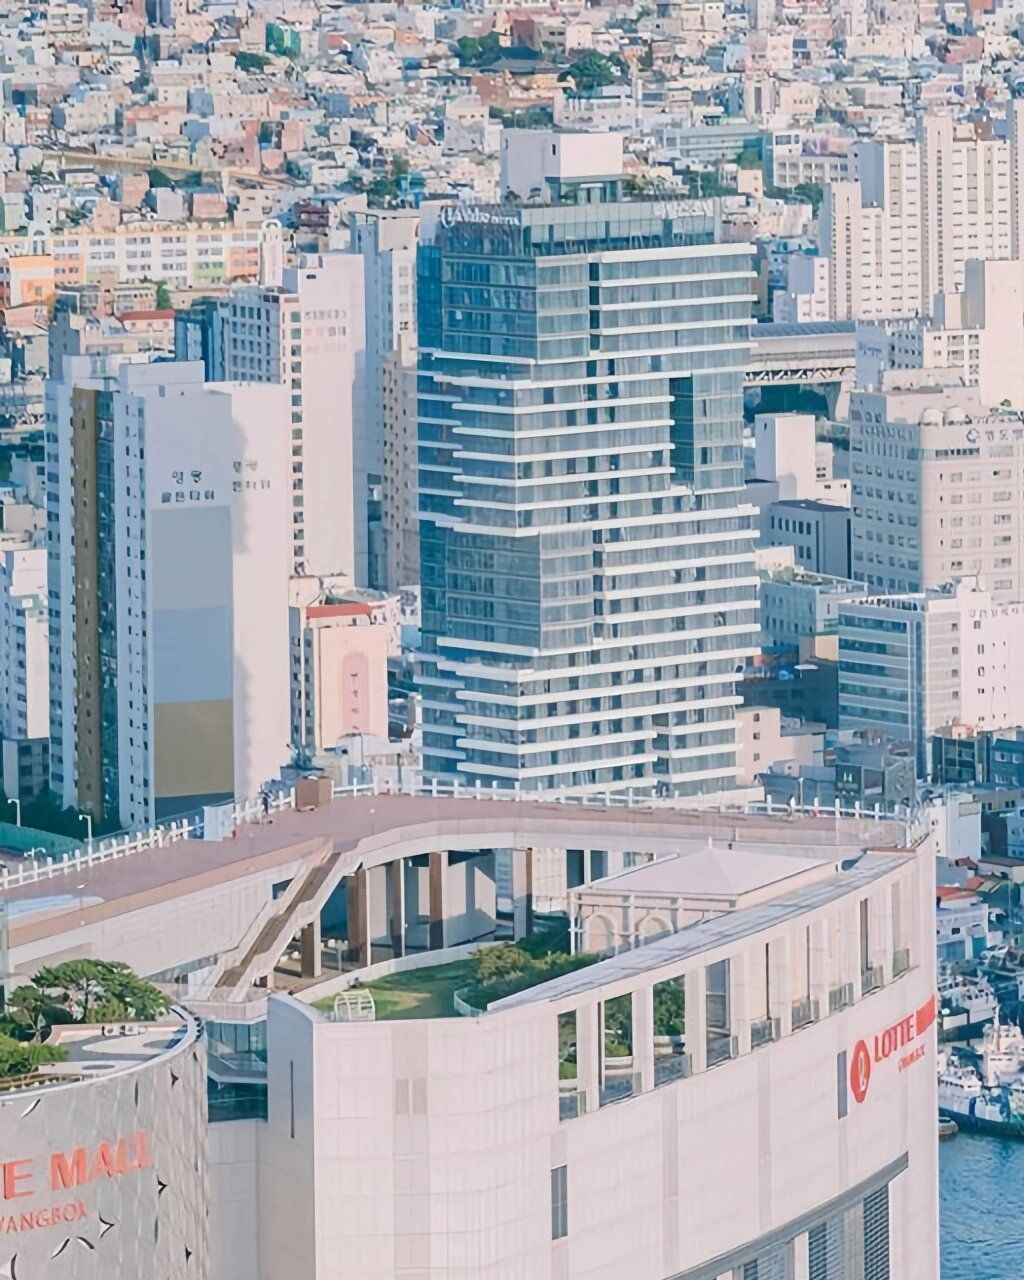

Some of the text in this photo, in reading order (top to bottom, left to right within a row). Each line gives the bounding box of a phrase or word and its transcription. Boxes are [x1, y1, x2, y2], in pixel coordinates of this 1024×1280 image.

[874, 1013, 915, 1063] LOTTE
[0, 1130, 152, 1200] E MALL
